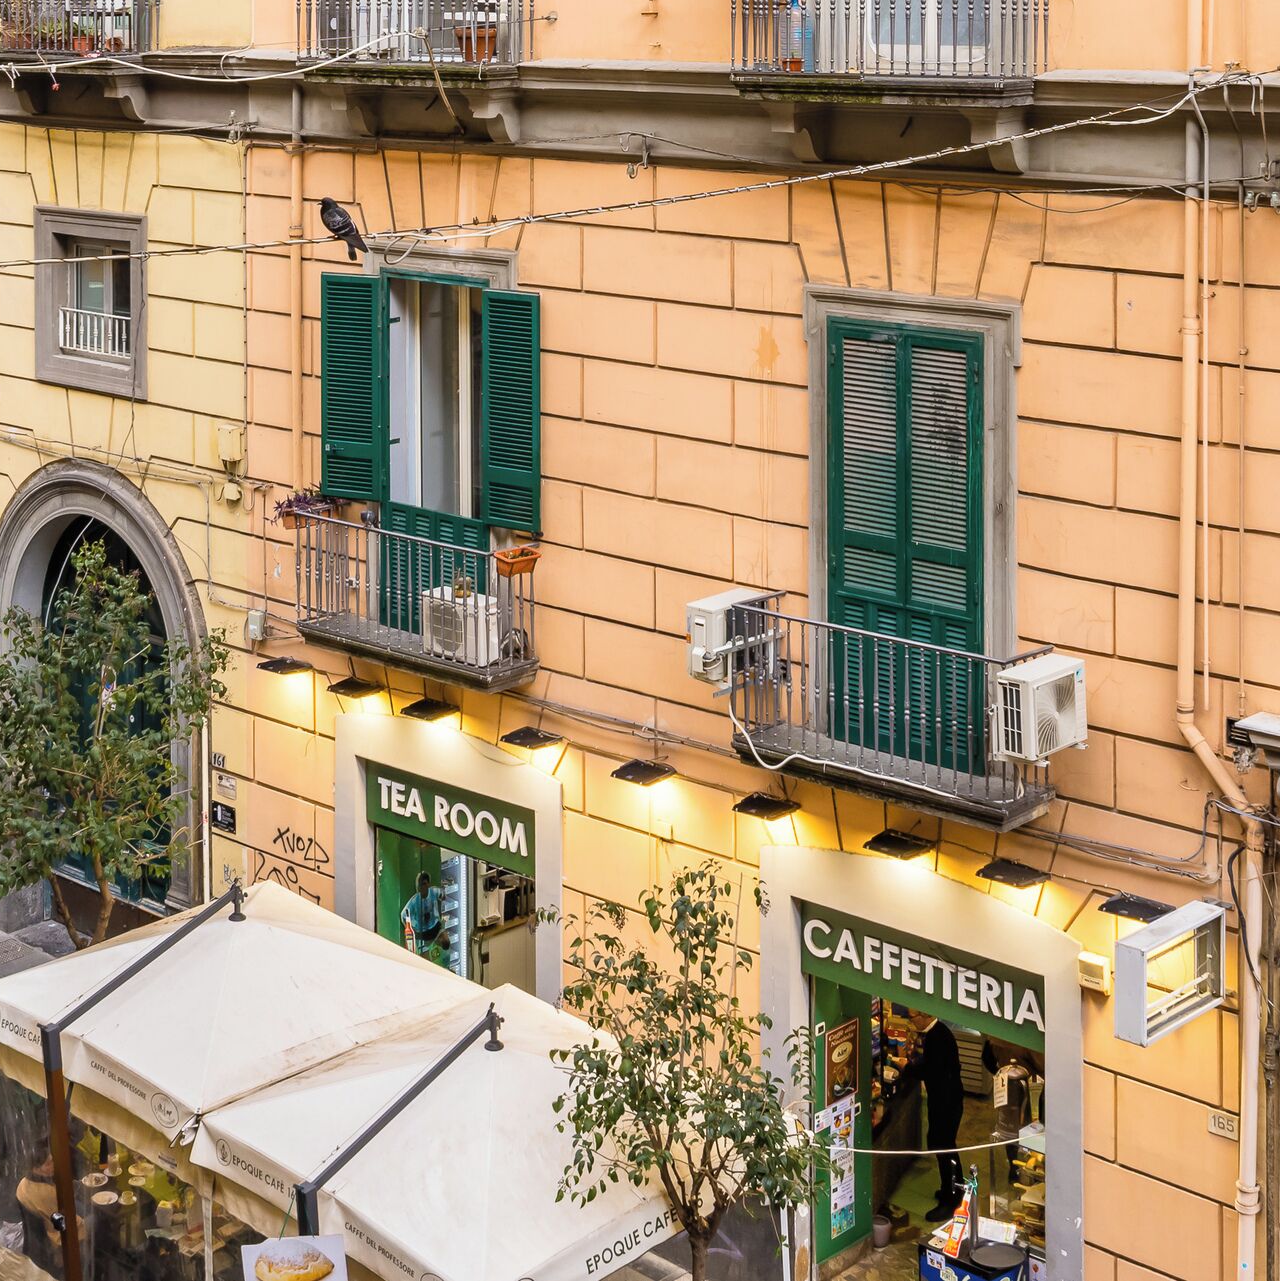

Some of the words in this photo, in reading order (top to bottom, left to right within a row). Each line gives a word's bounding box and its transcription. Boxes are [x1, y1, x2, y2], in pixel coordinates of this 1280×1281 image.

[213, 753, 225, 768] 161
[378, 777, 426, 823] TEA
[434, 795, 528, 857] ROOM
[803, 919, 1045, 1033] CAFFETTERIA
[1, 1019, 27, 1039] EPOQUE
[27, 1033, 41, 1046] CAF
[108, 1070, 117, 1083] DEL
[117, 1075, 147, 1101] PROFESSORE
[1212, 1114, 1235, 1133] 165
[232, 1154, 263, 1181] EPOQUE
[344, 1221, 365, 1240] CAFFE'
[365, 1236, 378, 1250] DEL
[377, 1245, 415, 1278] PROFESSORE
[585, 1229, 641, 1275] EPOQUE
